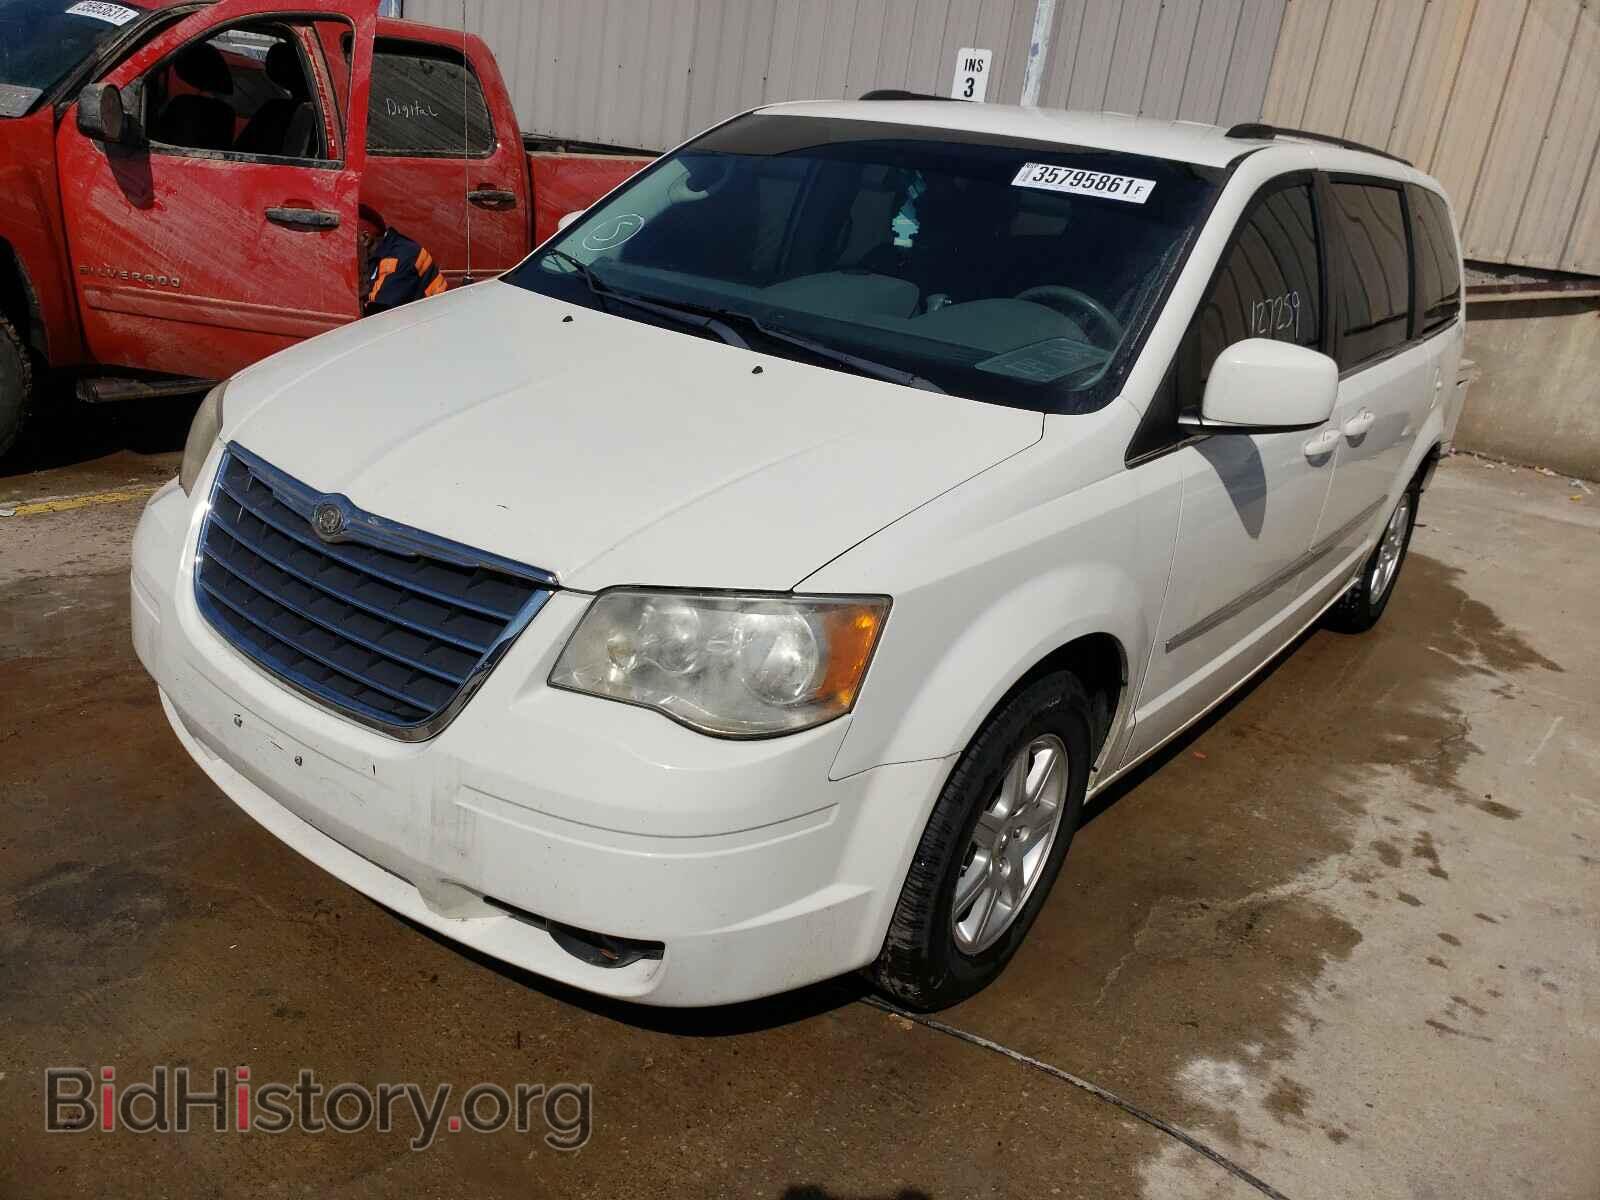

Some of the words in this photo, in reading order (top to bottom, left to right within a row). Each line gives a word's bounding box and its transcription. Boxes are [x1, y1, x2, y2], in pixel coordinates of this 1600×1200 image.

[964, 58, 984, 73] INS
[963, 77, 975, 98] 3
[385, 98, 439, 118] Digital
[1032, 166, 1135, 195] 35795861
[1251, 291, 1300, 339] 127259
